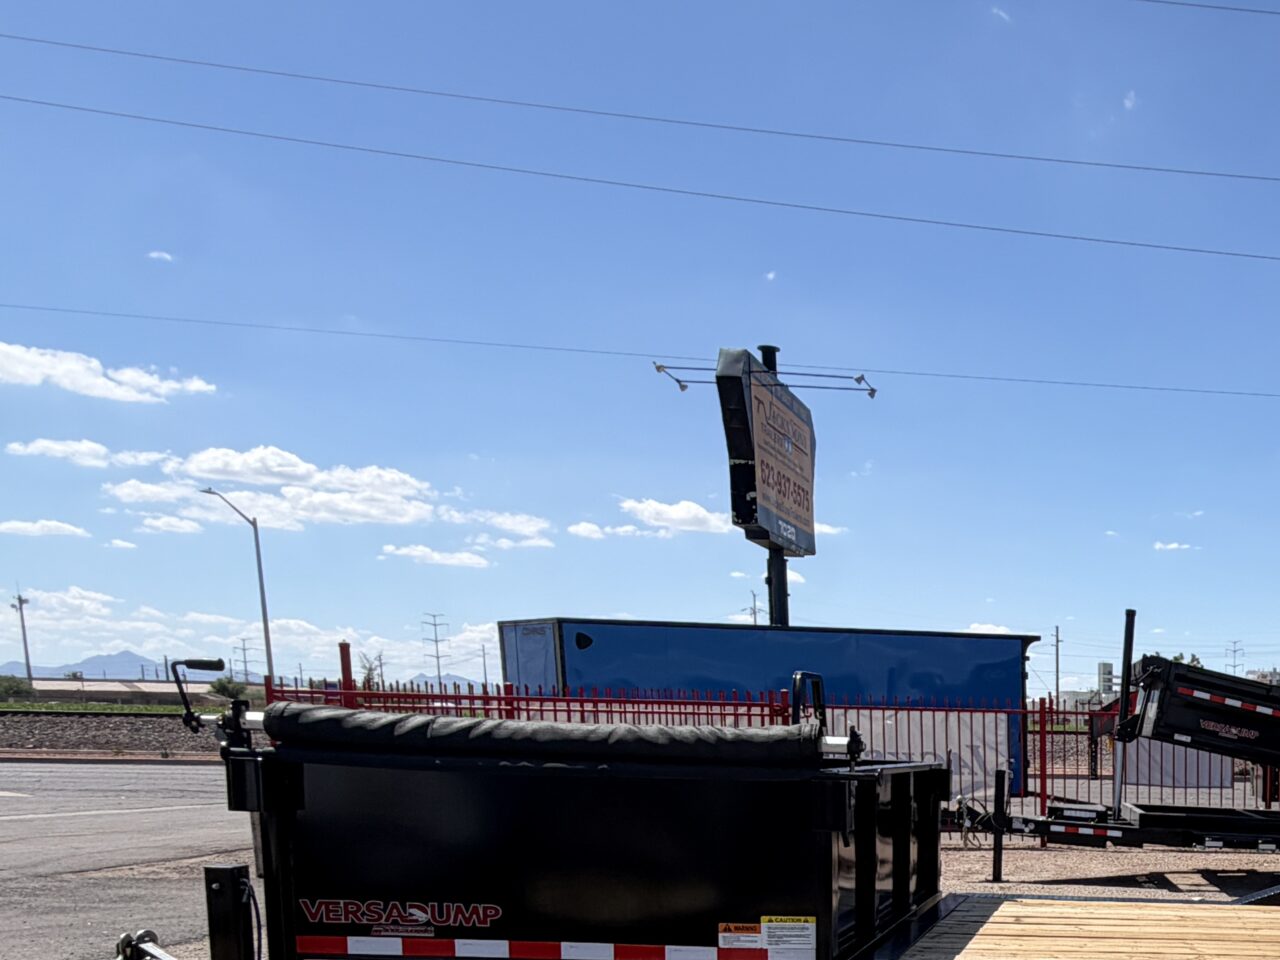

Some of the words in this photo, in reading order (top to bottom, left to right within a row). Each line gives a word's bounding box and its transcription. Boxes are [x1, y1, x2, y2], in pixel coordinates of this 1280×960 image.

[760, 459, 810, 513] 623-937-5575
[299, 899, 502, 927] VERSADUMP
[733, 924, 757, 932] WARNING
